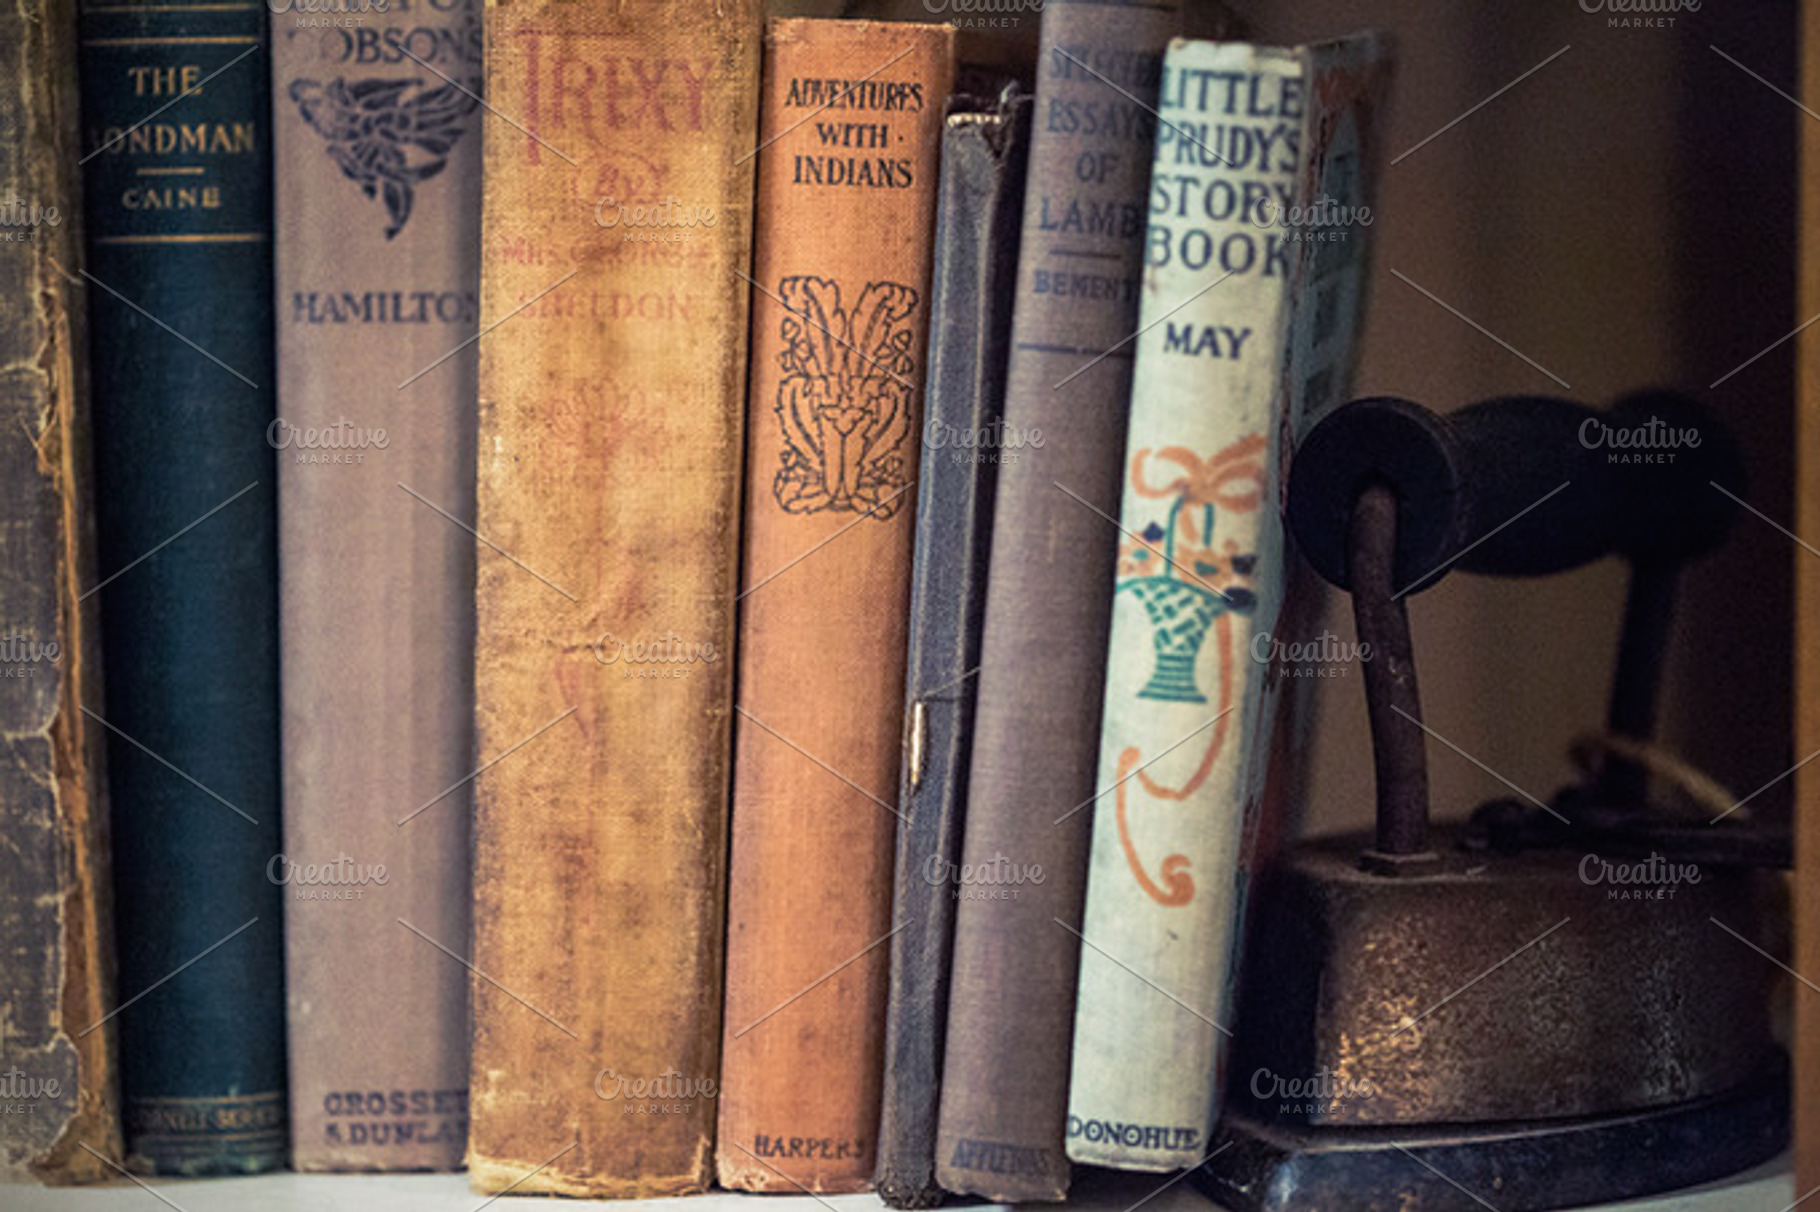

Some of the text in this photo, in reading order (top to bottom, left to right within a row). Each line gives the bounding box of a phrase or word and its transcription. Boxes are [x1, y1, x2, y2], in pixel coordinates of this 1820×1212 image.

[128, 65, 203, 97] THE
[785, 77, 924, 113] ADVENTURES
[1161, 65, 1304, 119] LITTLE
[815, 122, 889, 149] WITH
[792, 155, 914, 189] INDIANS
[1075, 150, 1120, 185] OF
[121, 186, 221, 210] CAINE
[1039, 196, 1140, 238] LAMB
[1147, 223, 1290, 277] BOOK
[1163, 321, 1253, 360] MAY
[1068, 1115, 1200, 1151] DONOHUE
